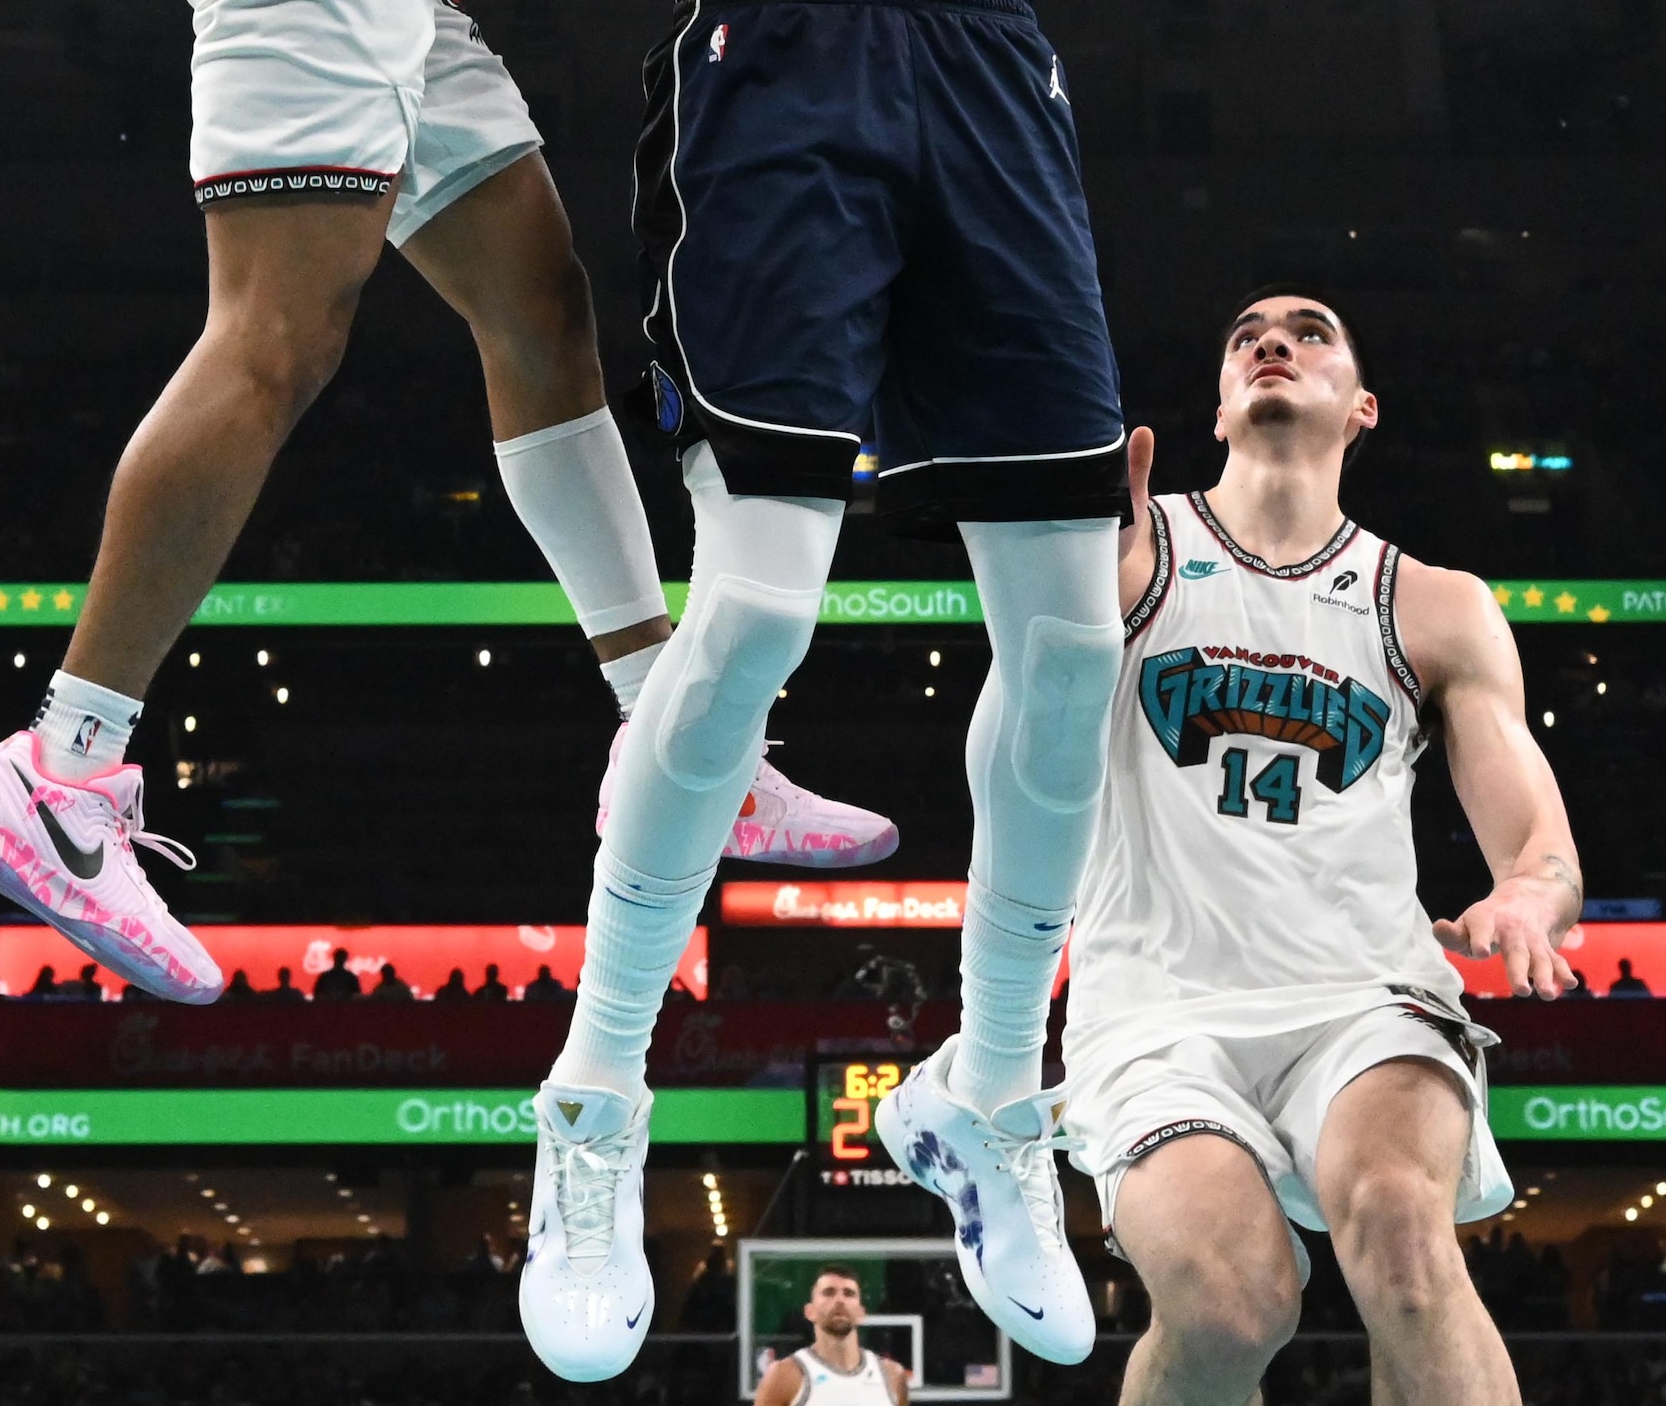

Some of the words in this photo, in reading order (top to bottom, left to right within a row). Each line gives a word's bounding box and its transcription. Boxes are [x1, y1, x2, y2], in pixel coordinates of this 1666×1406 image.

[1185, 558, 1219, 574] NIKE
[823, 587, 967, 617] hoSouth
[1312, 593, 1370, 616] Robinhood
[1203, 645, 1341, 684] VANCOUVER
[1139, 645, 1390, 793] GRIZZLIES
[1217, 745, 1303, 826] 14
[846, 1064, 900, 1099] 6:2
[397, 1098, 536, 1135] OrthoS
[850, 1169, 913, 1186] TISSO
